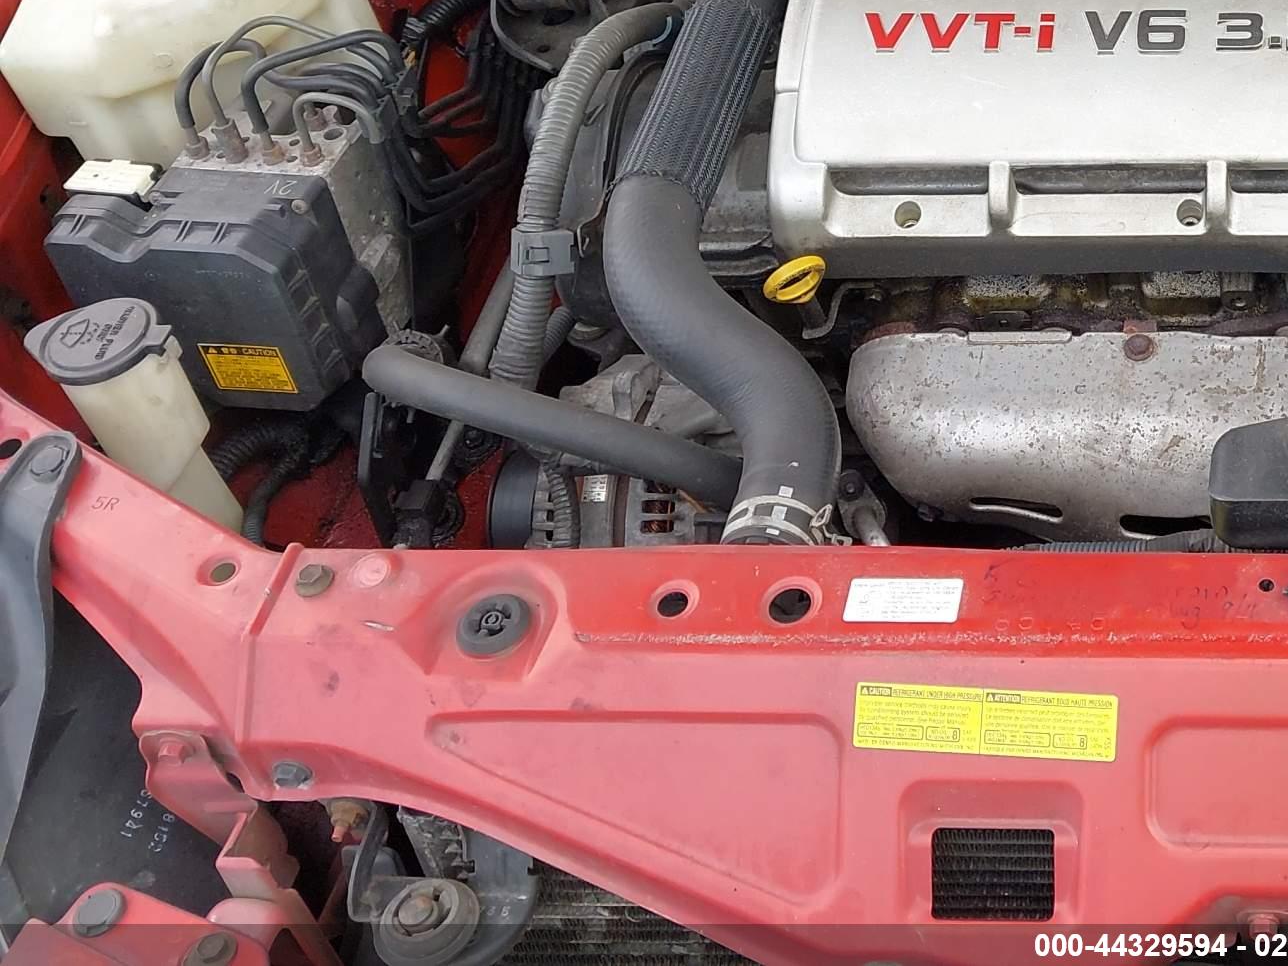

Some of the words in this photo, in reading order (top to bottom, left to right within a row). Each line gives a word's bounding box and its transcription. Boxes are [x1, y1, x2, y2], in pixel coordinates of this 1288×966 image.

[865, 11, 1056, 52] VVT-i
[1084, 10, 1187, 54] V6
[241, 347, 277, 357] CAUTION
[868, 687, 892, 696] CAUTION
[957, 692, 982, 700] PRESSURE
